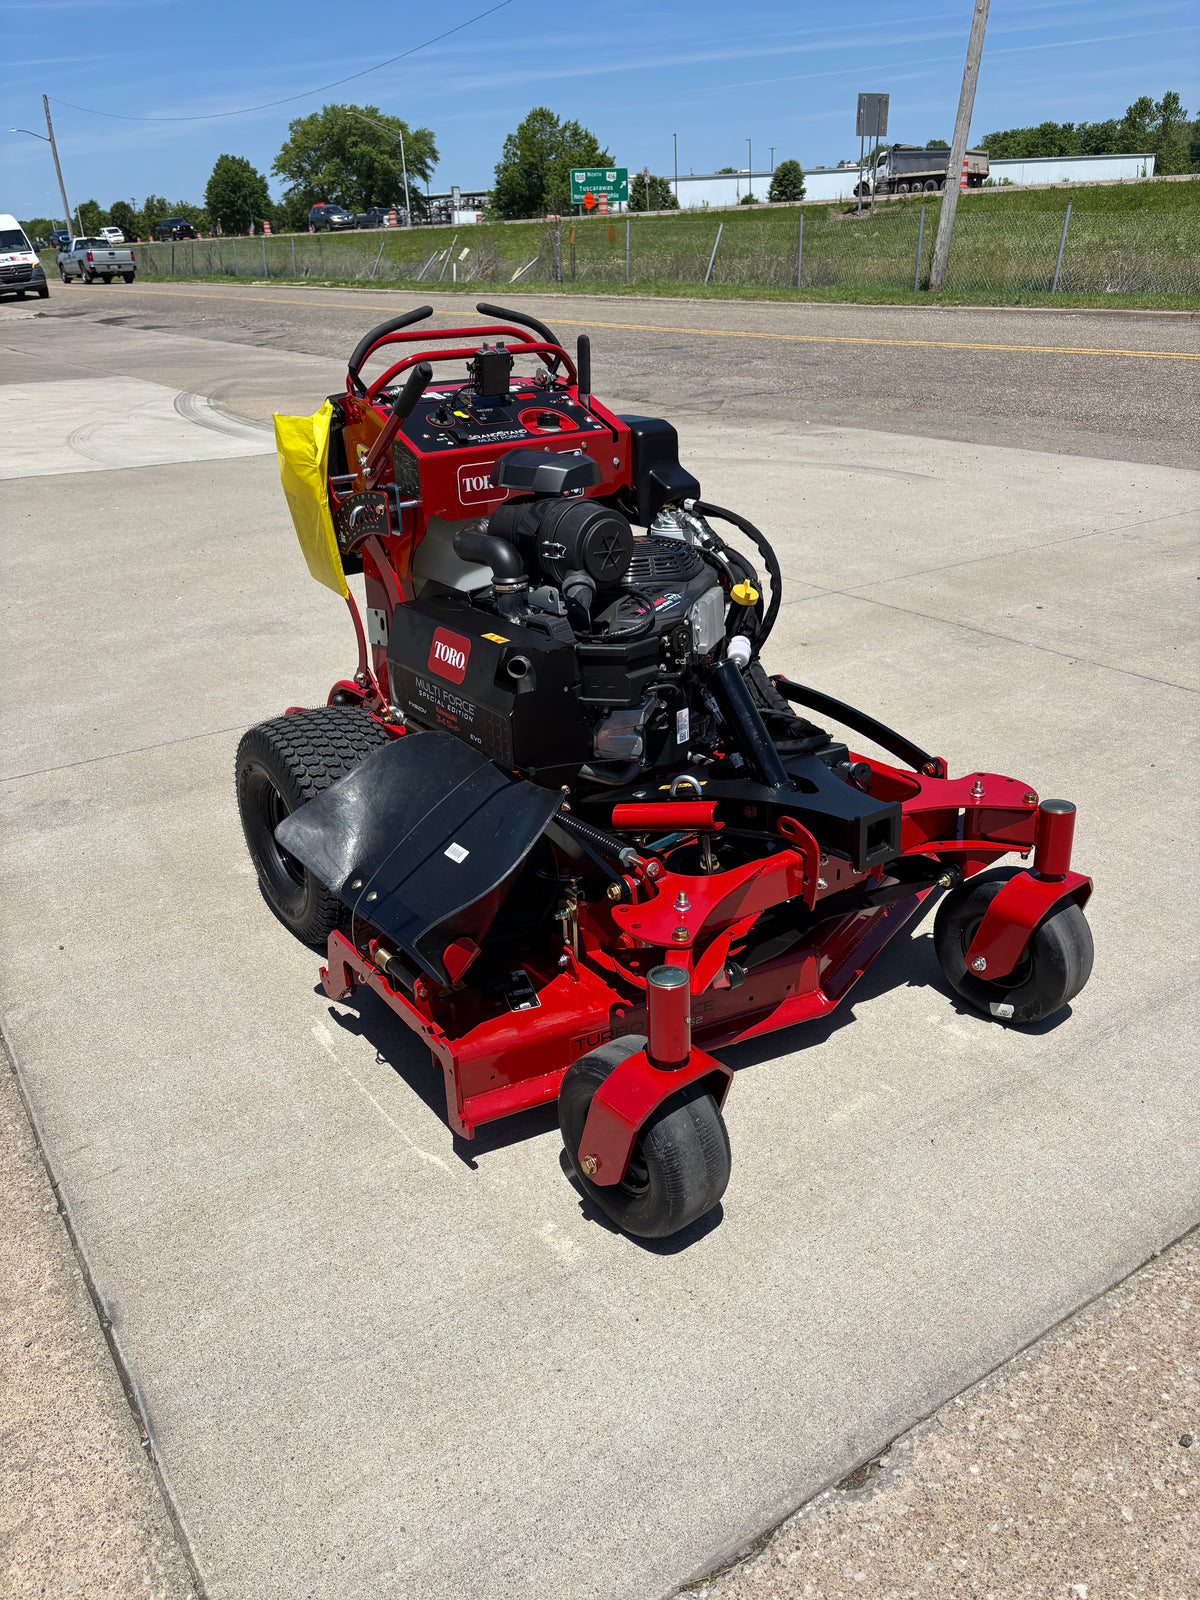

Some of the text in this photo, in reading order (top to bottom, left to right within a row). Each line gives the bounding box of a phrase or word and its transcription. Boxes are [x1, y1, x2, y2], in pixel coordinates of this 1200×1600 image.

[462, 475, 494, 492] TOR
[434, 641, 465, 669] TORO
[416, 677, 476, 716] MULTI FORCE
[418, 689, 474, 722] SPECIAL EDITION
[574, 1021, 644, 1050] TURBO
